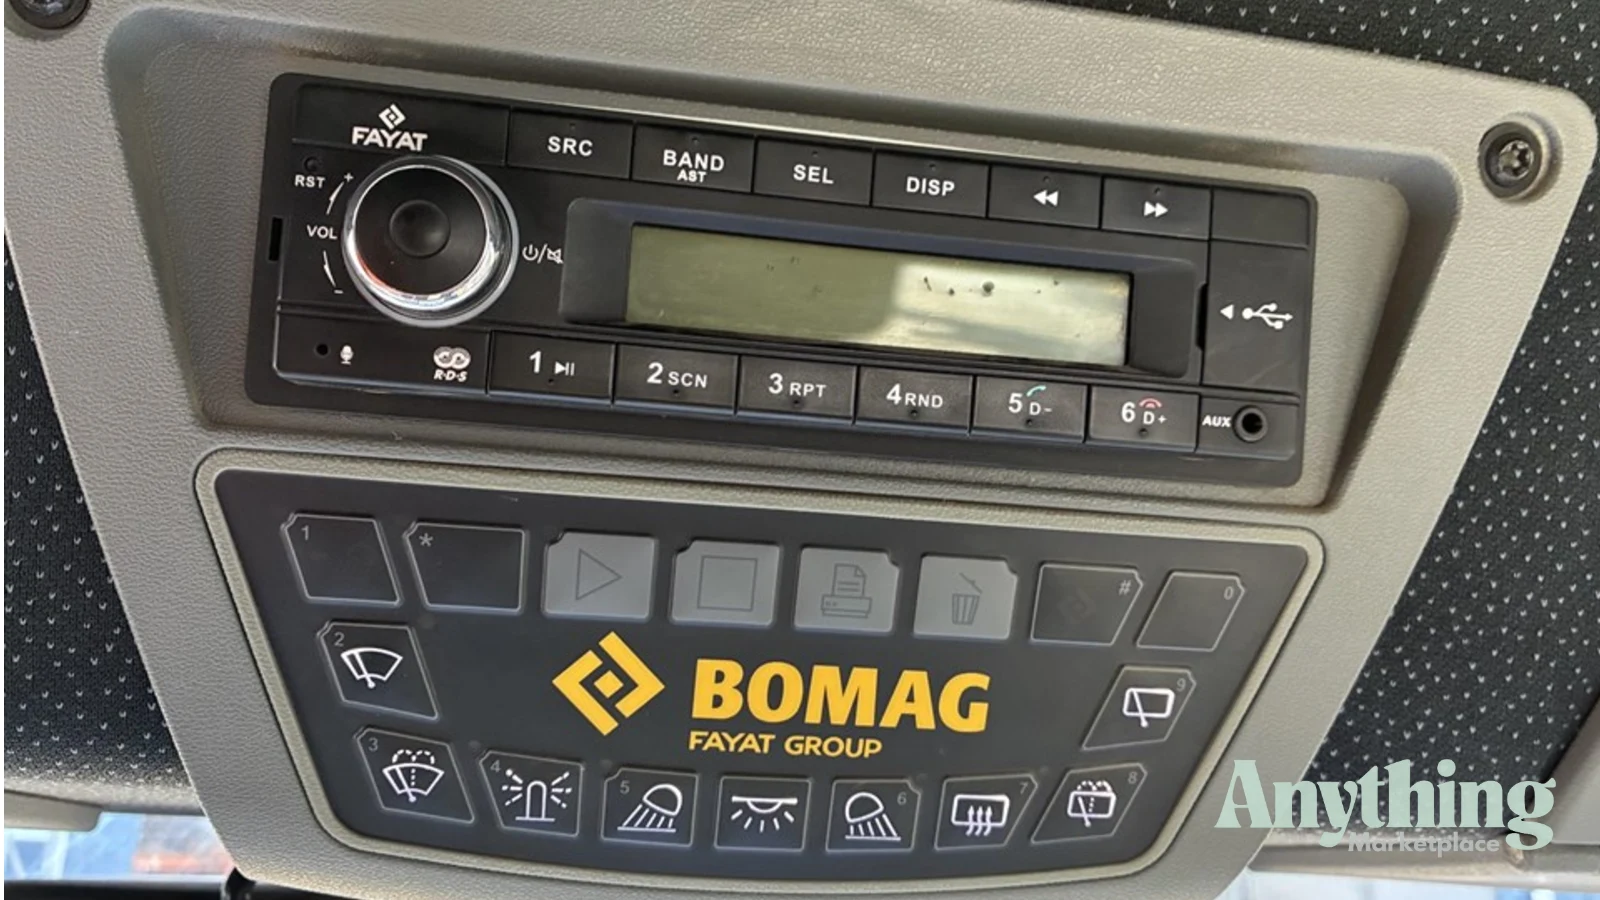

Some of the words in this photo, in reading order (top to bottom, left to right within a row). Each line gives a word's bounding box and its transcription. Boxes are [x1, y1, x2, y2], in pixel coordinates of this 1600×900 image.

[352, 126, 428, 151] FAYAT
[547, 136, 593, 157] SRC
[662, 149, 725, 172] BAND
[294, 174, 325, 189] RST
[676, 169, 707, 183] AST
[793, 164, 834, 185] SEL
[906, 176, 955, 197] DISP
[306, 225, 337, 240] VOL
[529, 350, 542, 374] 1
[647, 362, 664, 385] 2
[668, 370, 708, 388] SCN
[768, 373, 784, 395] 3
[789, 382, 827, 398] RPT
[886, 383, 902, 405] 4
[905, 392, 943, 409] RND
[1008, 391, 1023, 414] 5
[1121, 400, 1135, 423] 6
[1202, 414, 1231, 428] AUX
[334, 632, 345, 647] 2
[691, 658, 991, 733] BOMAG
[368, 737, 379, 751] 3
[688, 730, 776, 755] FAYAT
[784, 735, 883, 759] GROUP
[490, 759, 501, 773] 4
[620, 780, 630, 794] 5
